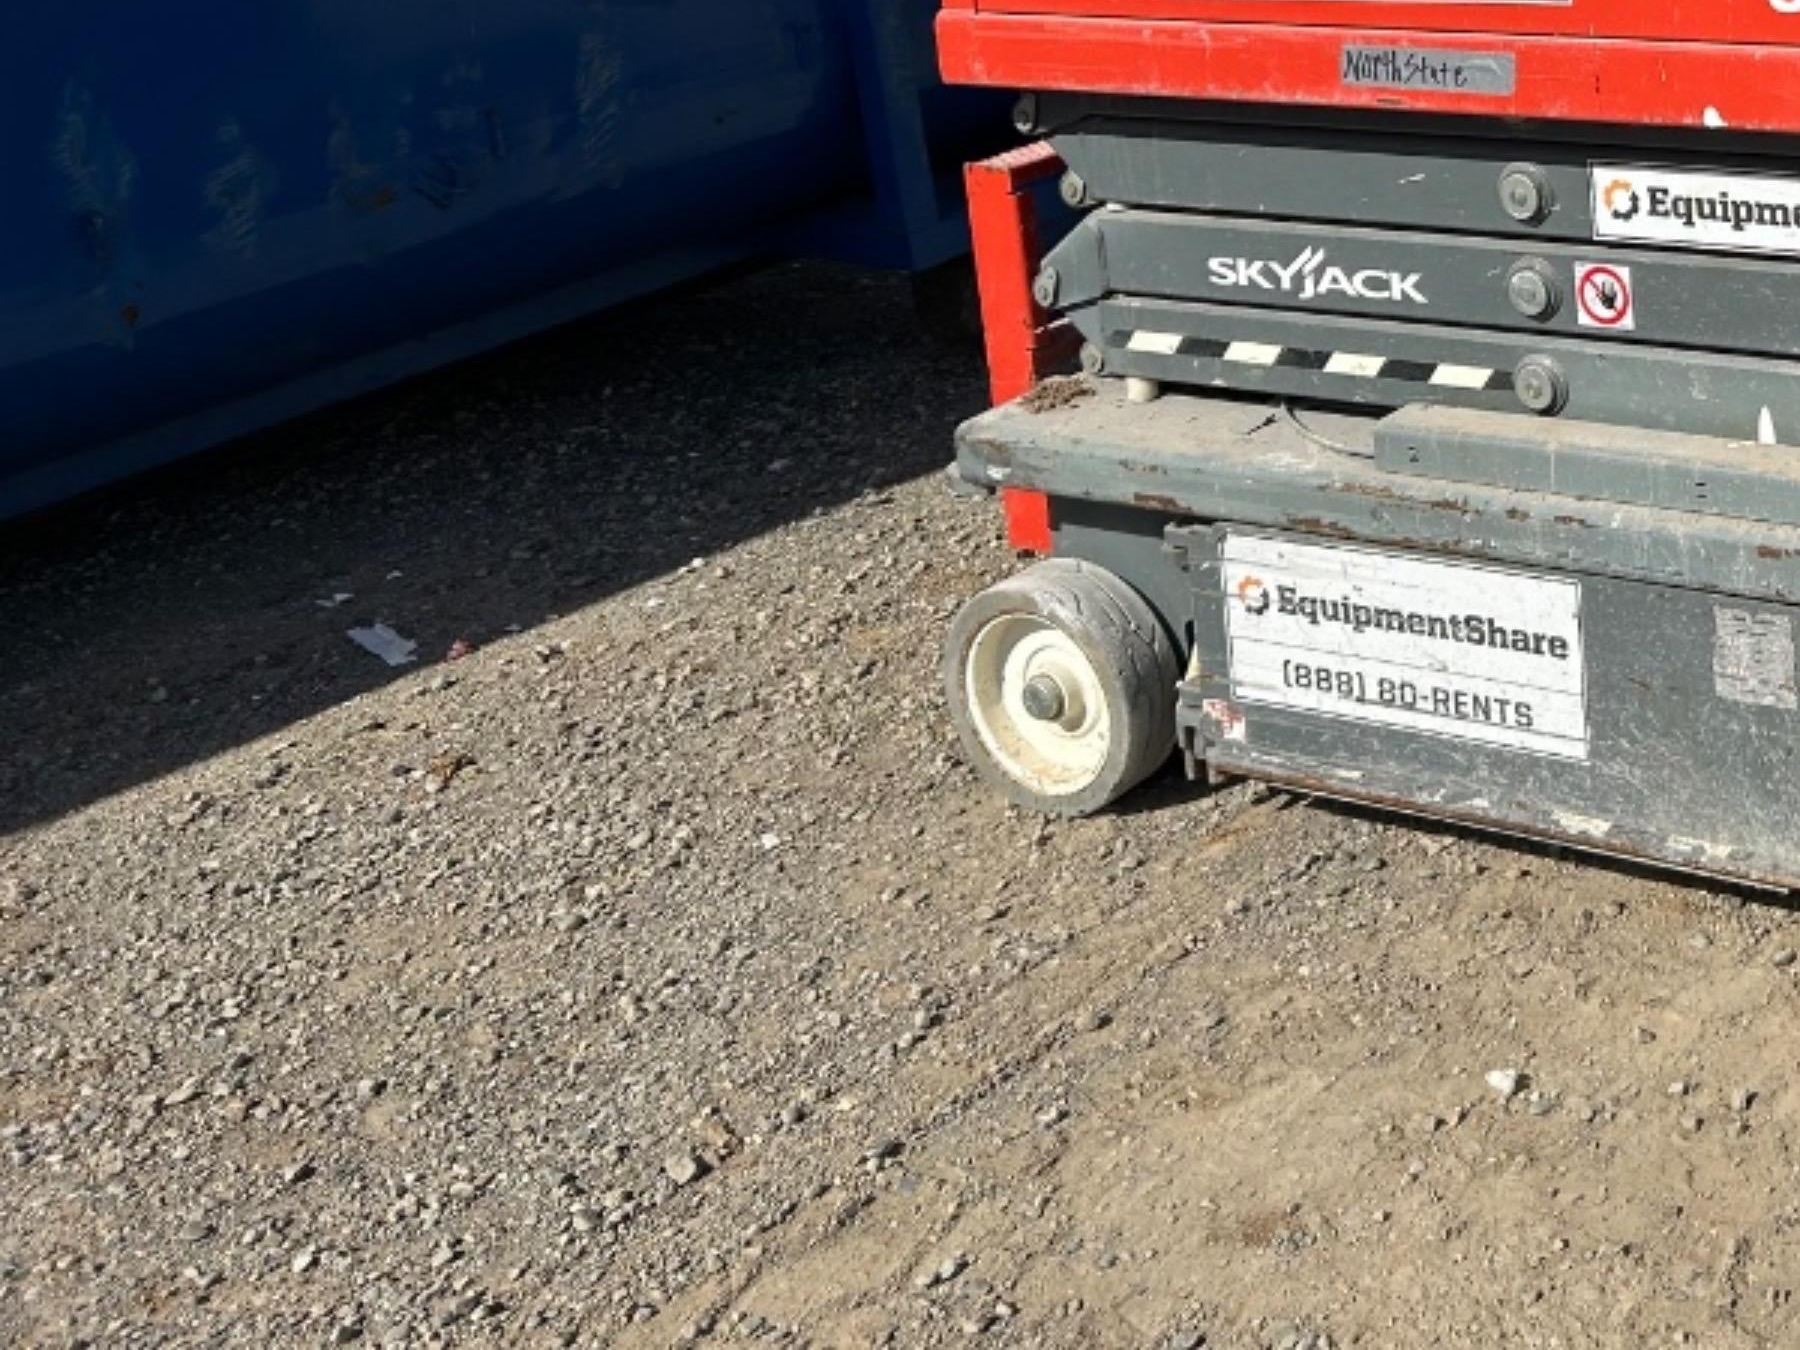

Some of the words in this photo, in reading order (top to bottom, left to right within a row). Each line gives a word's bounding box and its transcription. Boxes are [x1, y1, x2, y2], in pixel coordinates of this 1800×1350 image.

[1207, 245, 1430, 304] SKYJACK
[1276, 584, 1571, 660] EquipmentShare
[1282, 659, 1367, 702] (888)
[1378, 677, 1535, 728] 80-RENTS
